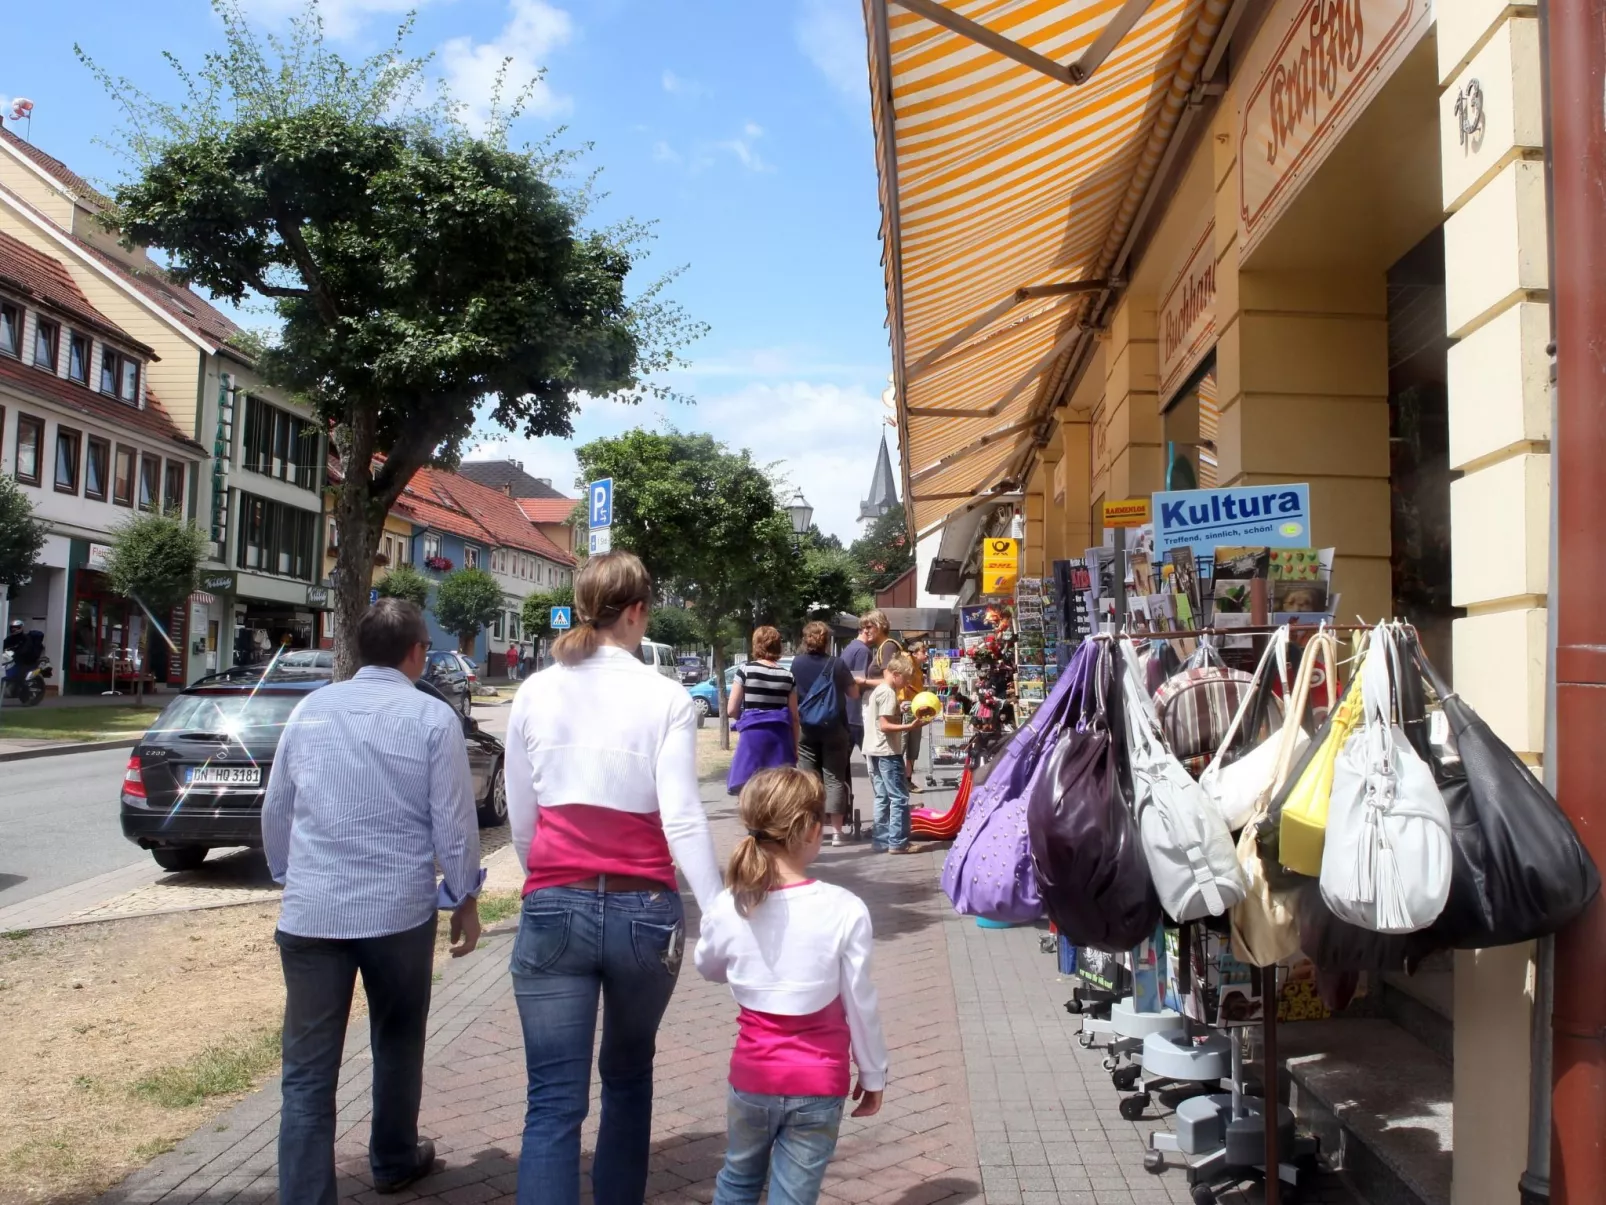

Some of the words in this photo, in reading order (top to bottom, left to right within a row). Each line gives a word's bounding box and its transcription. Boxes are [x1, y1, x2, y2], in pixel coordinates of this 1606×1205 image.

[1454, 78, 1480, 146] 13
[210, 372, 230, 542] SALAMANDER
[594, 486, 606, 522] P
[1161, 491, 1301, 529] Kultura
[1164, 534, 1202, 545] Treffend,
[1205, 529, 1241, 540] sinnlich,
[1244, 524, 1273, 535] schön!
[232, 769, 259, 782] 3181
